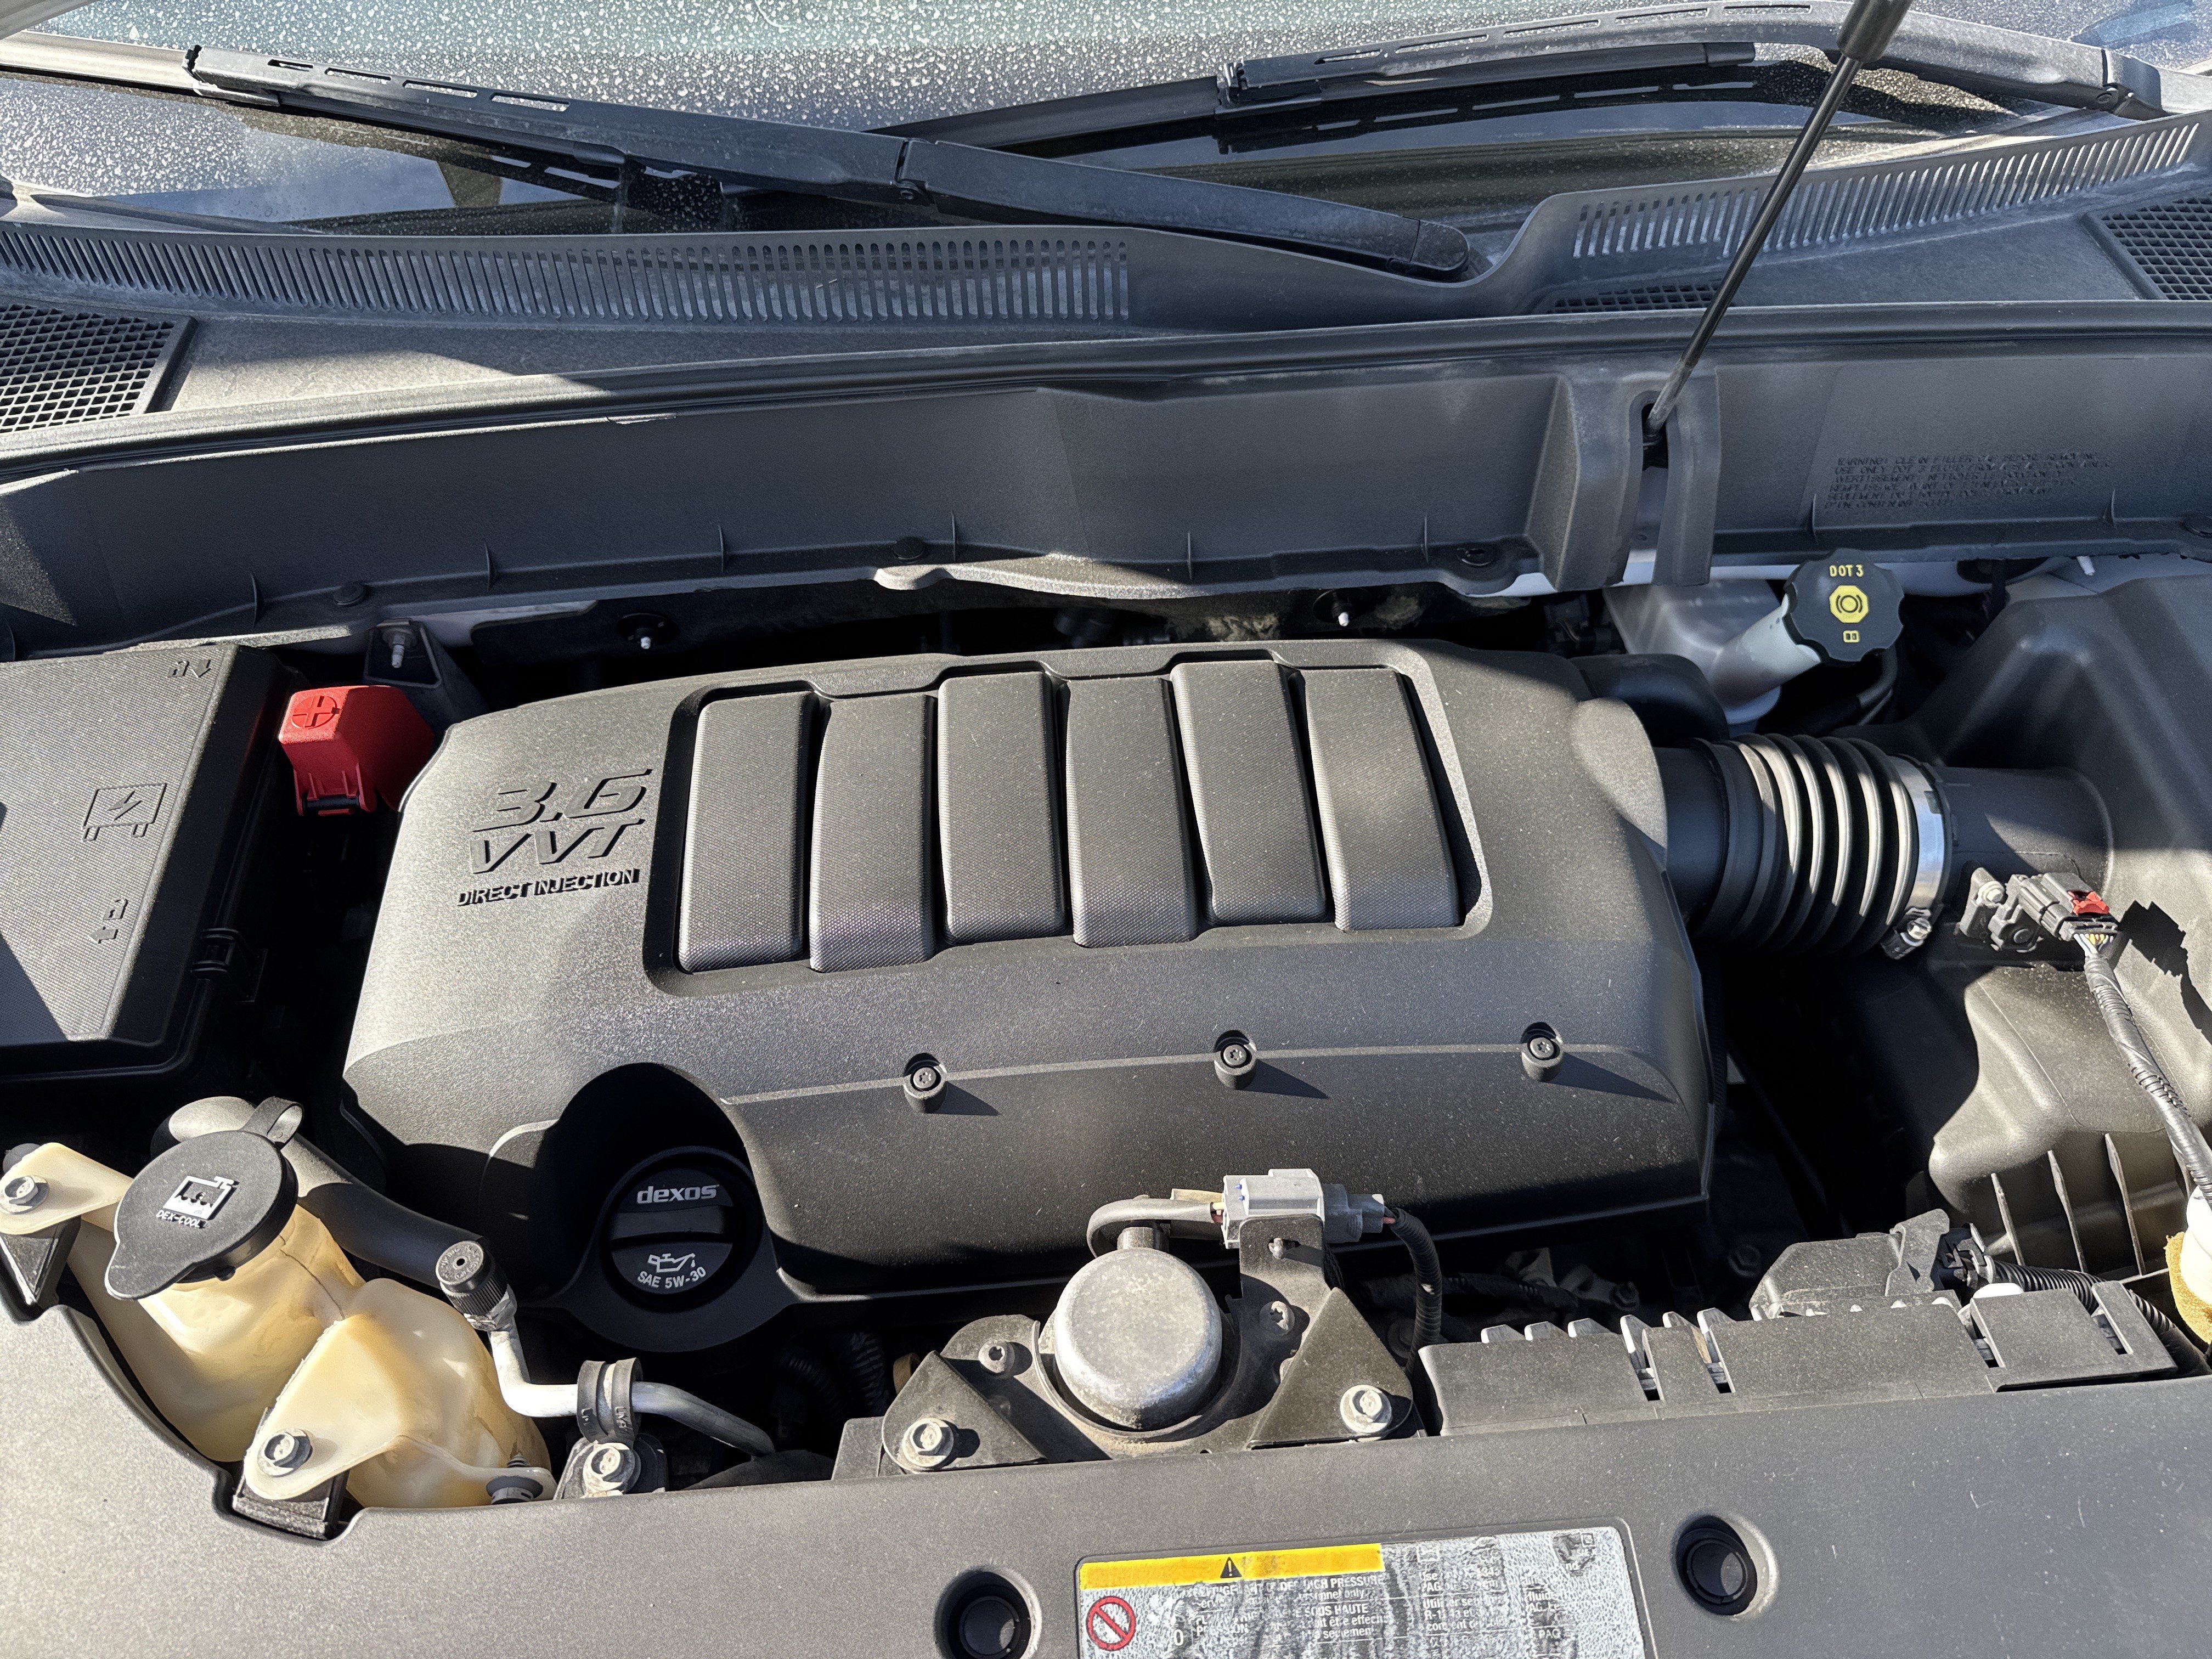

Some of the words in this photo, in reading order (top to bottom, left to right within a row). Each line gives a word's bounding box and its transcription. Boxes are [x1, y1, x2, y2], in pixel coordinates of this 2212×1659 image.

[1830, 565, 1853, 577] DOT
[1856, 565, 1864, 577] 3
[472, 769, 653, 832] 3.6
[470, 819, 646, 874] VVT
[457, 882, 532, 906] DIRECT
[533, 868, 640, 895] INJECTION
[636, 1184, 720, 1204] dexos
[155, 1209, 202, 1228] DEX-COOL
[637, 1271, 661, 1288] SAE
[665, 1266, 706, 1288] 5W-30
[1334, 1603, 1369, 1616] HAUTE
